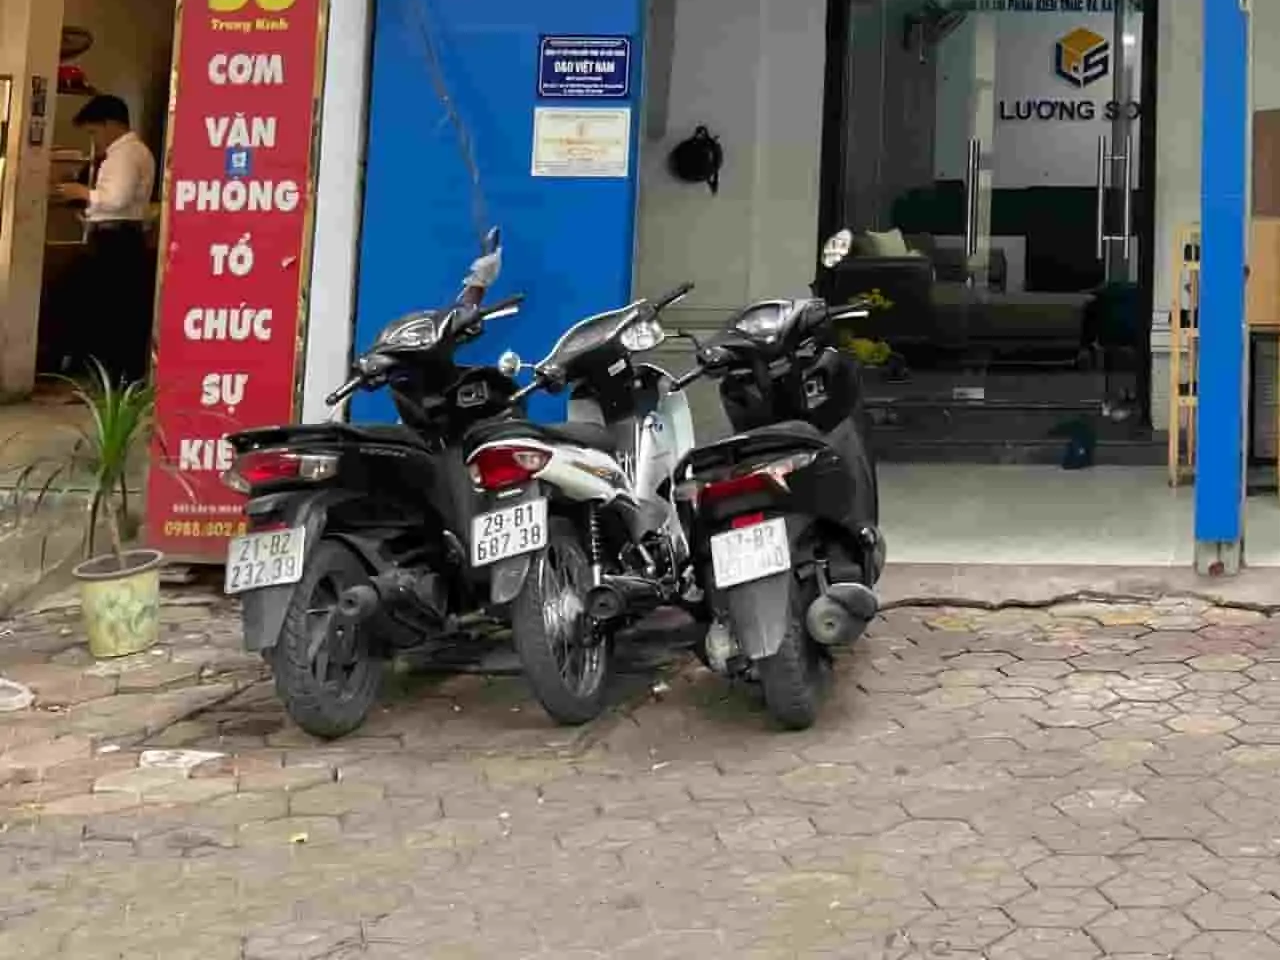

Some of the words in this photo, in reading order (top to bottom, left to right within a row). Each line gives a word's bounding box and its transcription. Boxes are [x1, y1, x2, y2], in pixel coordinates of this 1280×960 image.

[207, 53, 284, 85] CƠM
[1000, 98, 1095, 120] LƯƠNG
[205, 112, 277, 148] VĂN
[183, 302, 273, 340] CHỨC
[200, 373, 249, 414] SỰ
